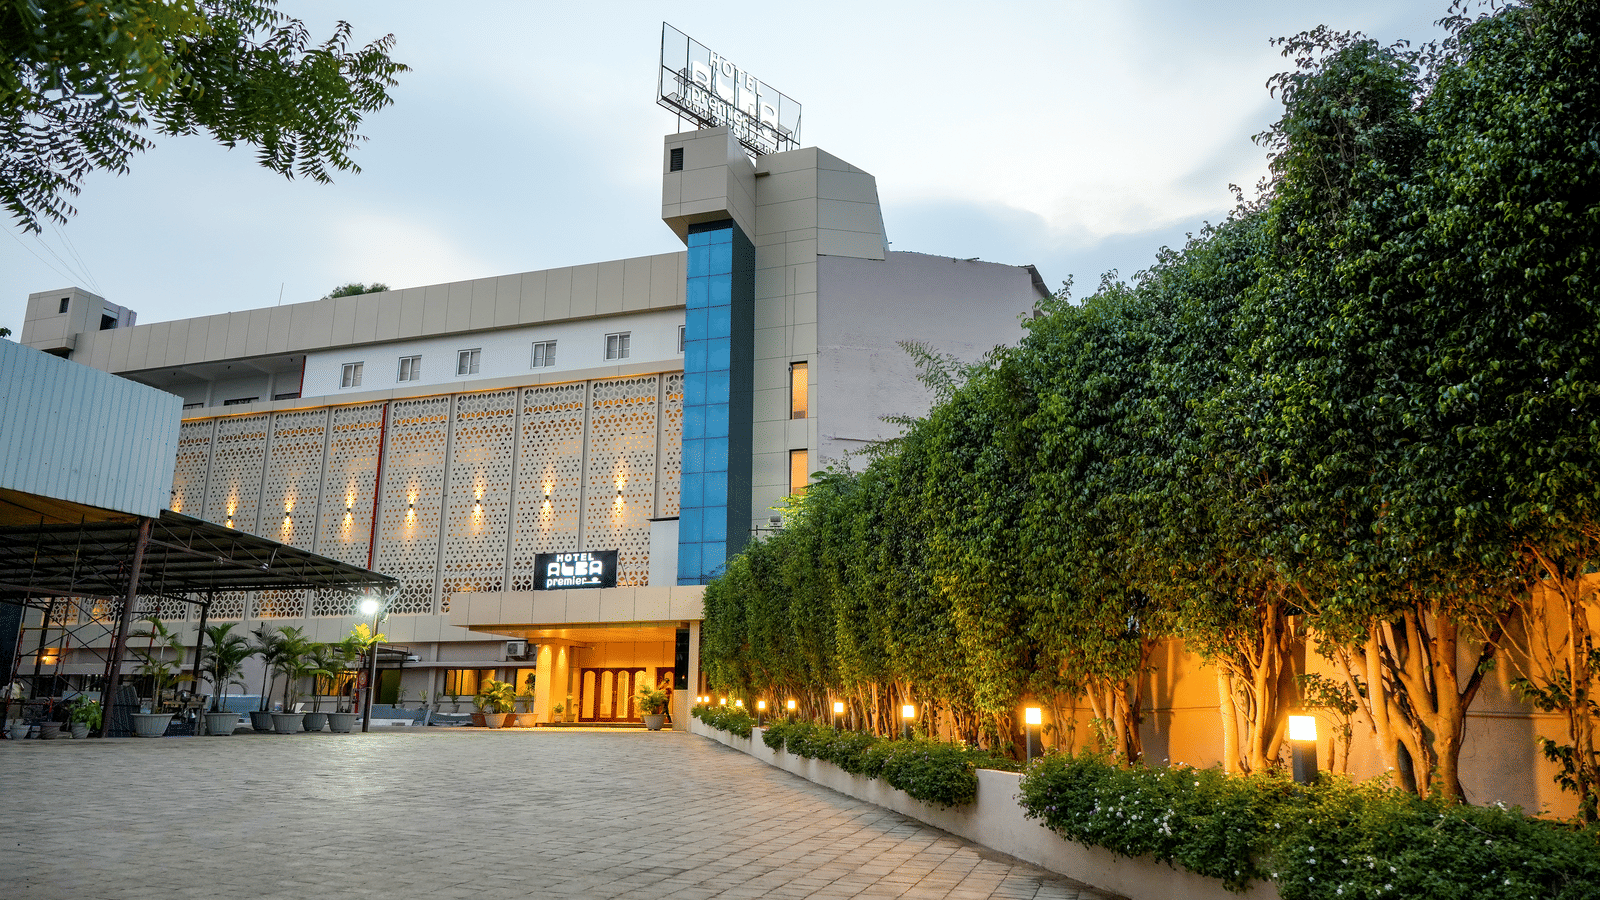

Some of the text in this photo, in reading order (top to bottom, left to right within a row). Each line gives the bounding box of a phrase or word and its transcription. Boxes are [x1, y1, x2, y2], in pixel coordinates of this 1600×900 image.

[709, 51, 762, 97] HOTEL
[691, 87, 751, 131] premier
[556, 553, 594, 562] HOTEL
[546, 576, 587, 588] premier
